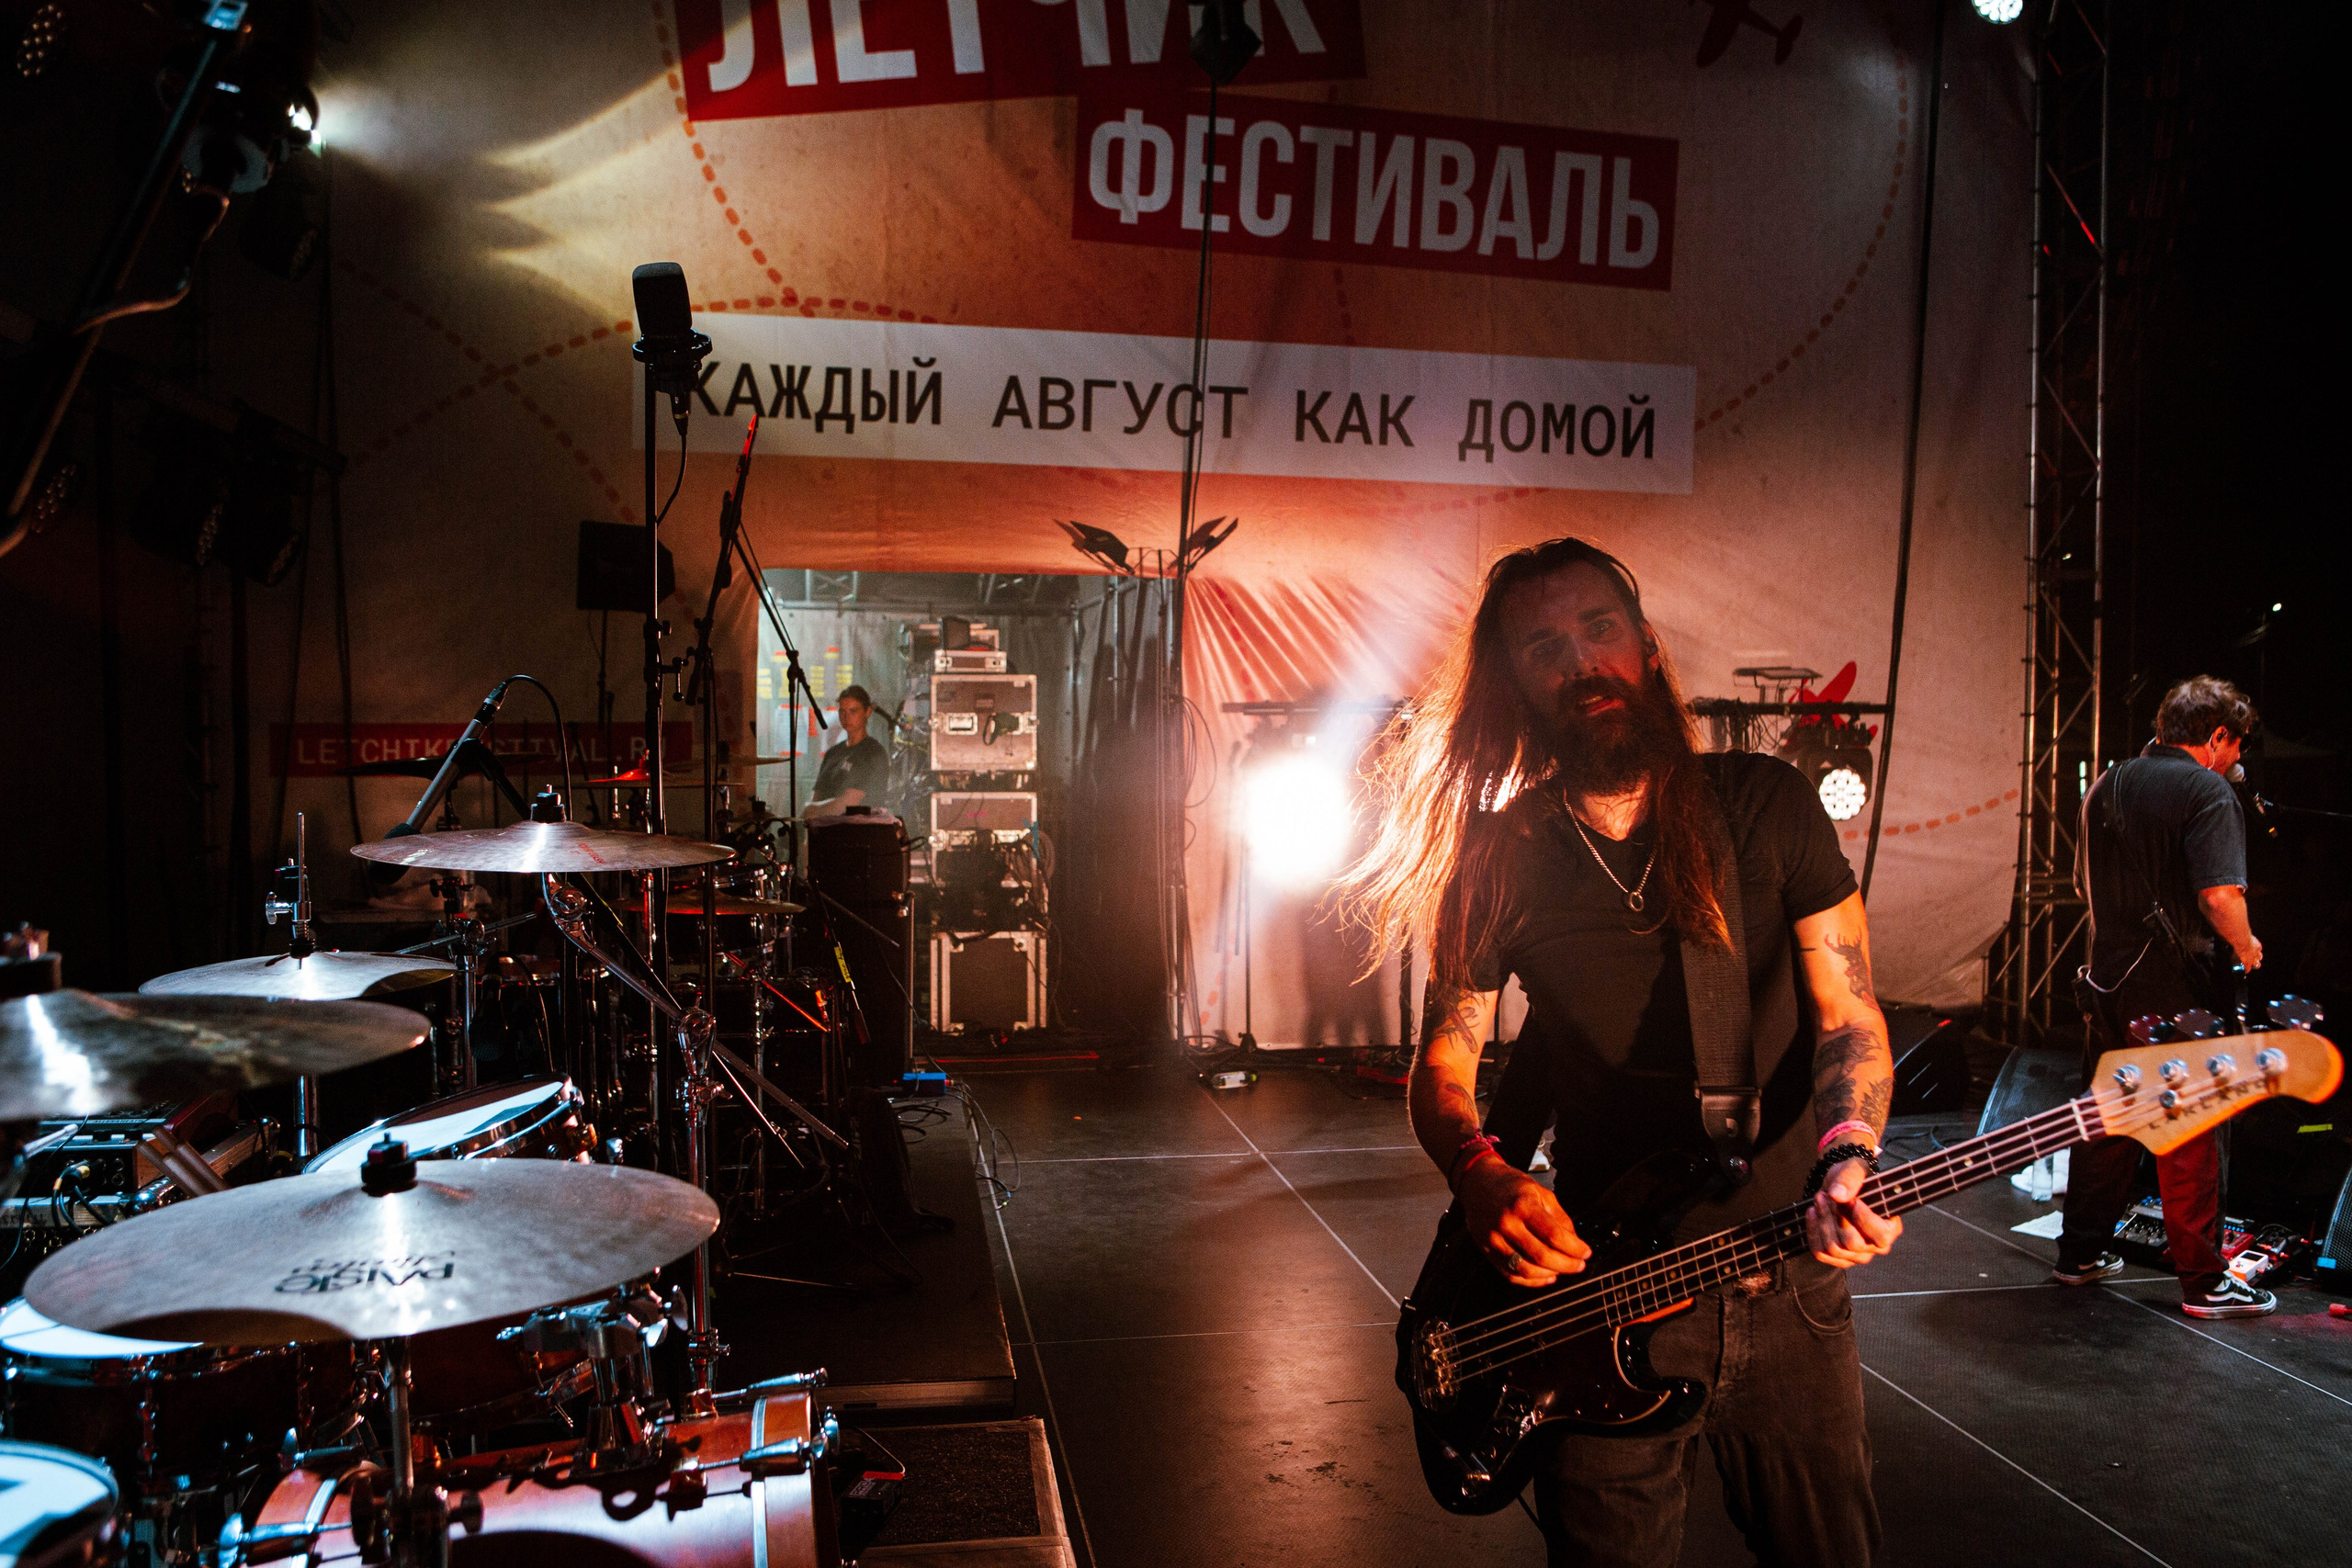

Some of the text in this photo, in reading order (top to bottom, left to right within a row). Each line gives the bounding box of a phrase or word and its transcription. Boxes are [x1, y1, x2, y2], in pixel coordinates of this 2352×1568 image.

[1089, 108, 1659, 269] ФЕСТИВАЛЬ
[689, 356, 1655, 463] КАЖДЫЙ АВГУСТ КАК ДОМОЙ
